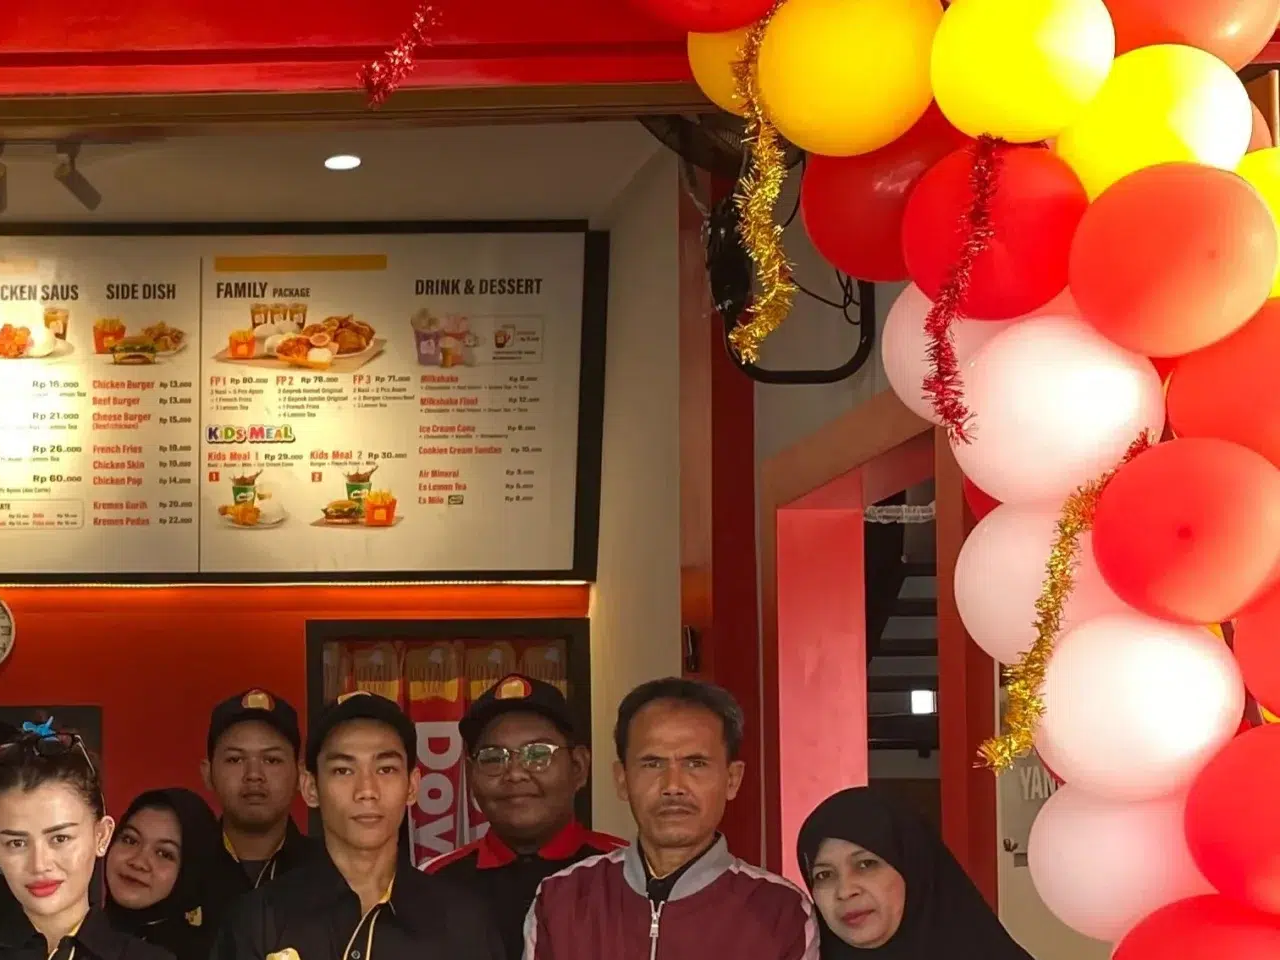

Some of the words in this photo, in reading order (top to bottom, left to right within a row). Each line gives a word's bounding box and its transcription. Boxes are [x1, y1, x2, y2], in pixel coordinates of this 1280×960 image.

[216, 282, 268, 298] FAMILY
[272, 287, 311, 298] PACKAGE
[415, 279, 461, 295] DRINK
[464, 280, 475, 295] &
[479, 278, 543, 295] DESSERT
[41, 284, 79, 300] SAUS
[106, 283, 139, 300] SIDE
[142, 283, 176, 300] DISH
[230, 377, 240, 385] Rp
[301, 376, 311, 384] Rp
[32, 380, 46, 390] Rp
[32, 412, 46, 421] Rp
[32, 445, 46, 454] Rp
[264, 453, 275, 461] Rp
[368, 452, 379, 460] Rp
[32, 475, 47, 484] Rp
